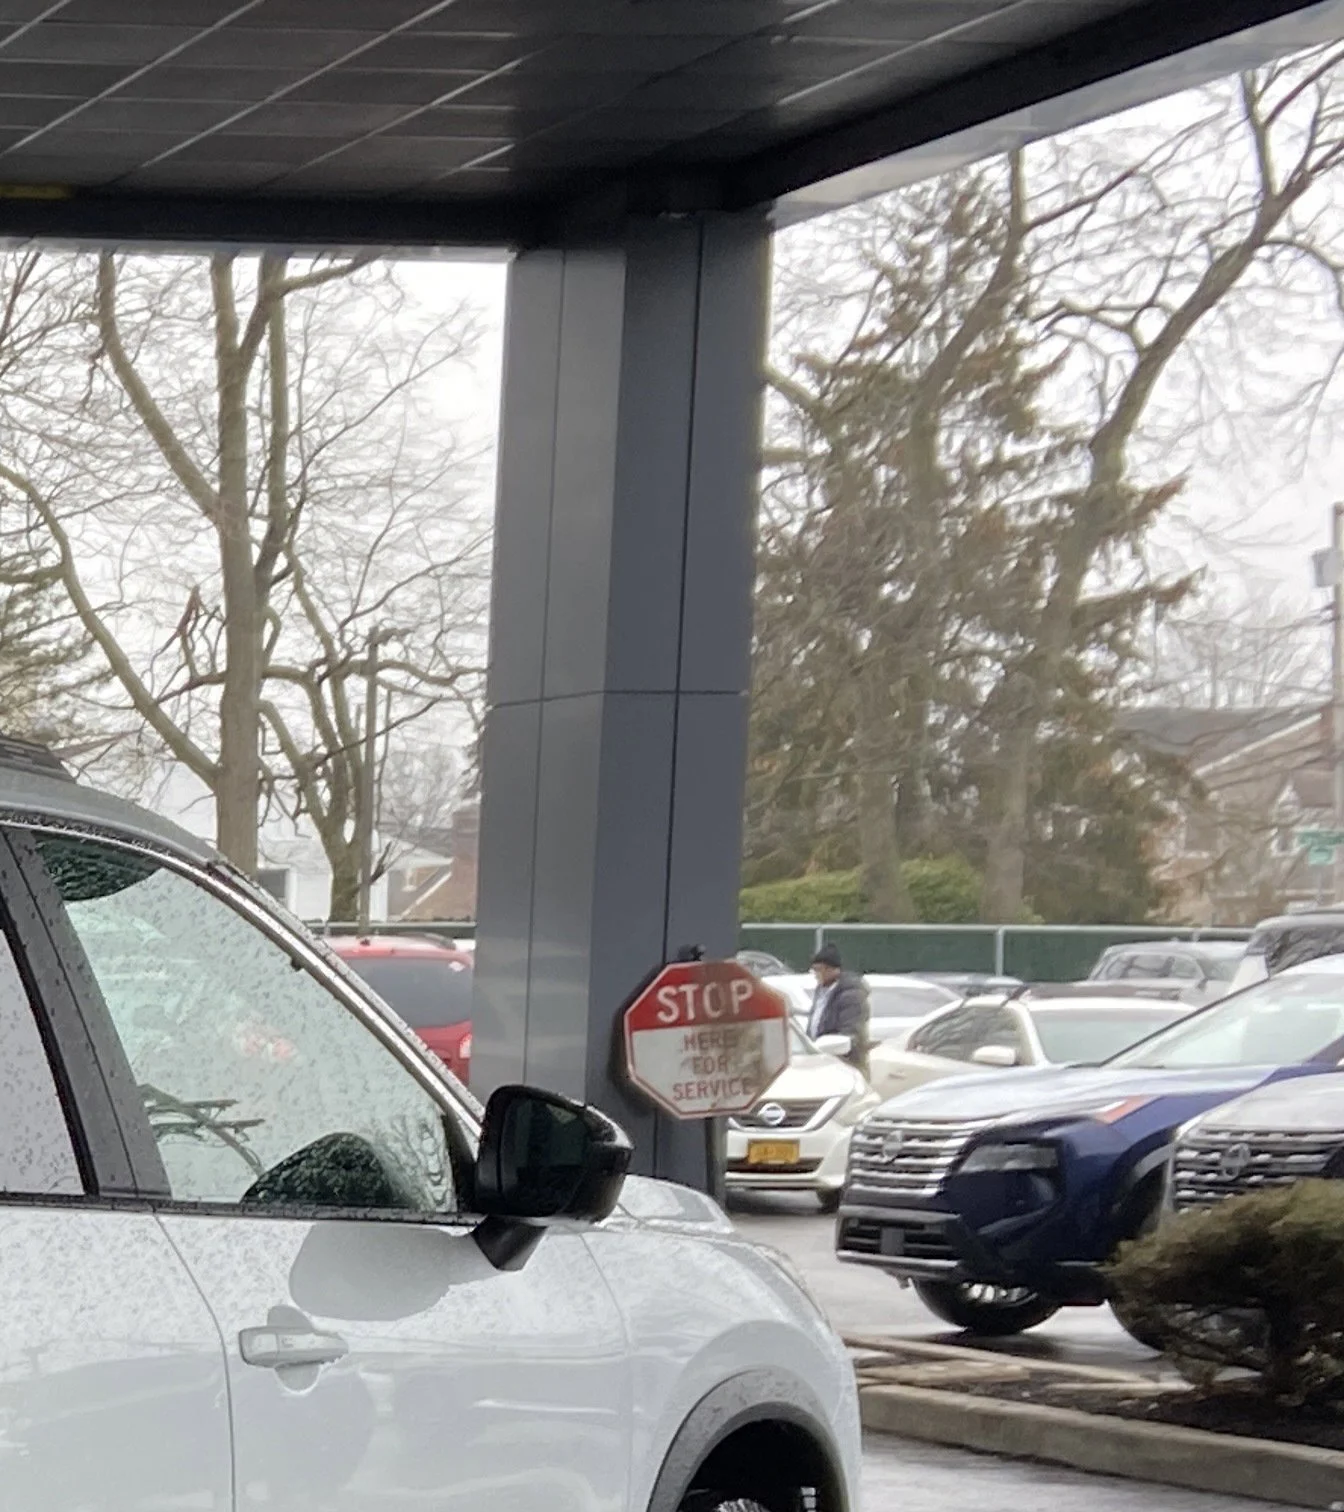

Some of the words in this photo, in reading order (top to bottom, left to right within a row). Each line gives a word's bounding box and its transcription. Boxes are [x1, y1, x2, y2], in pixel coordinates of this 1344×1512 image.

[656, 979, 753, 1023] STOP
[683, 1028, 739, 1051] HERE
[691, 1056, 730, 1075] FOR
[672, 1076, 754, 1100] SERVICE
